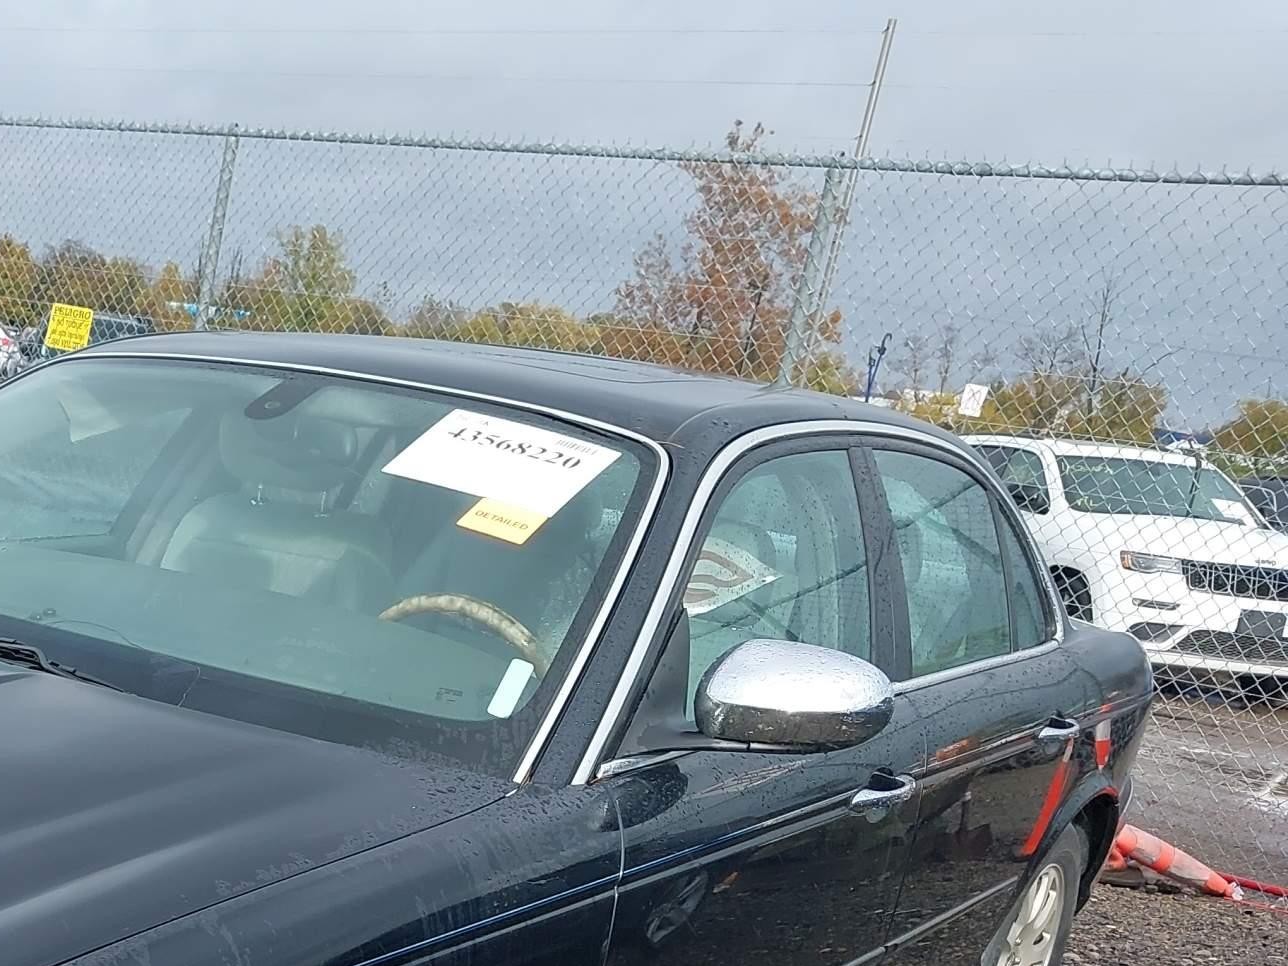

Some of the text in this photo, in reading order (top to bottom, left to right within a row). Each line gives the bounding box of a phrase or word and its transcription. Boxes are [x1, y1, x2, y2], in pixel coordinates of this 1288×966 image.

[54, 306, 91, 320] PELIGRO
[447, 427, 581, 470] 43568220
[475, 509, 529, 531] DETAILED
